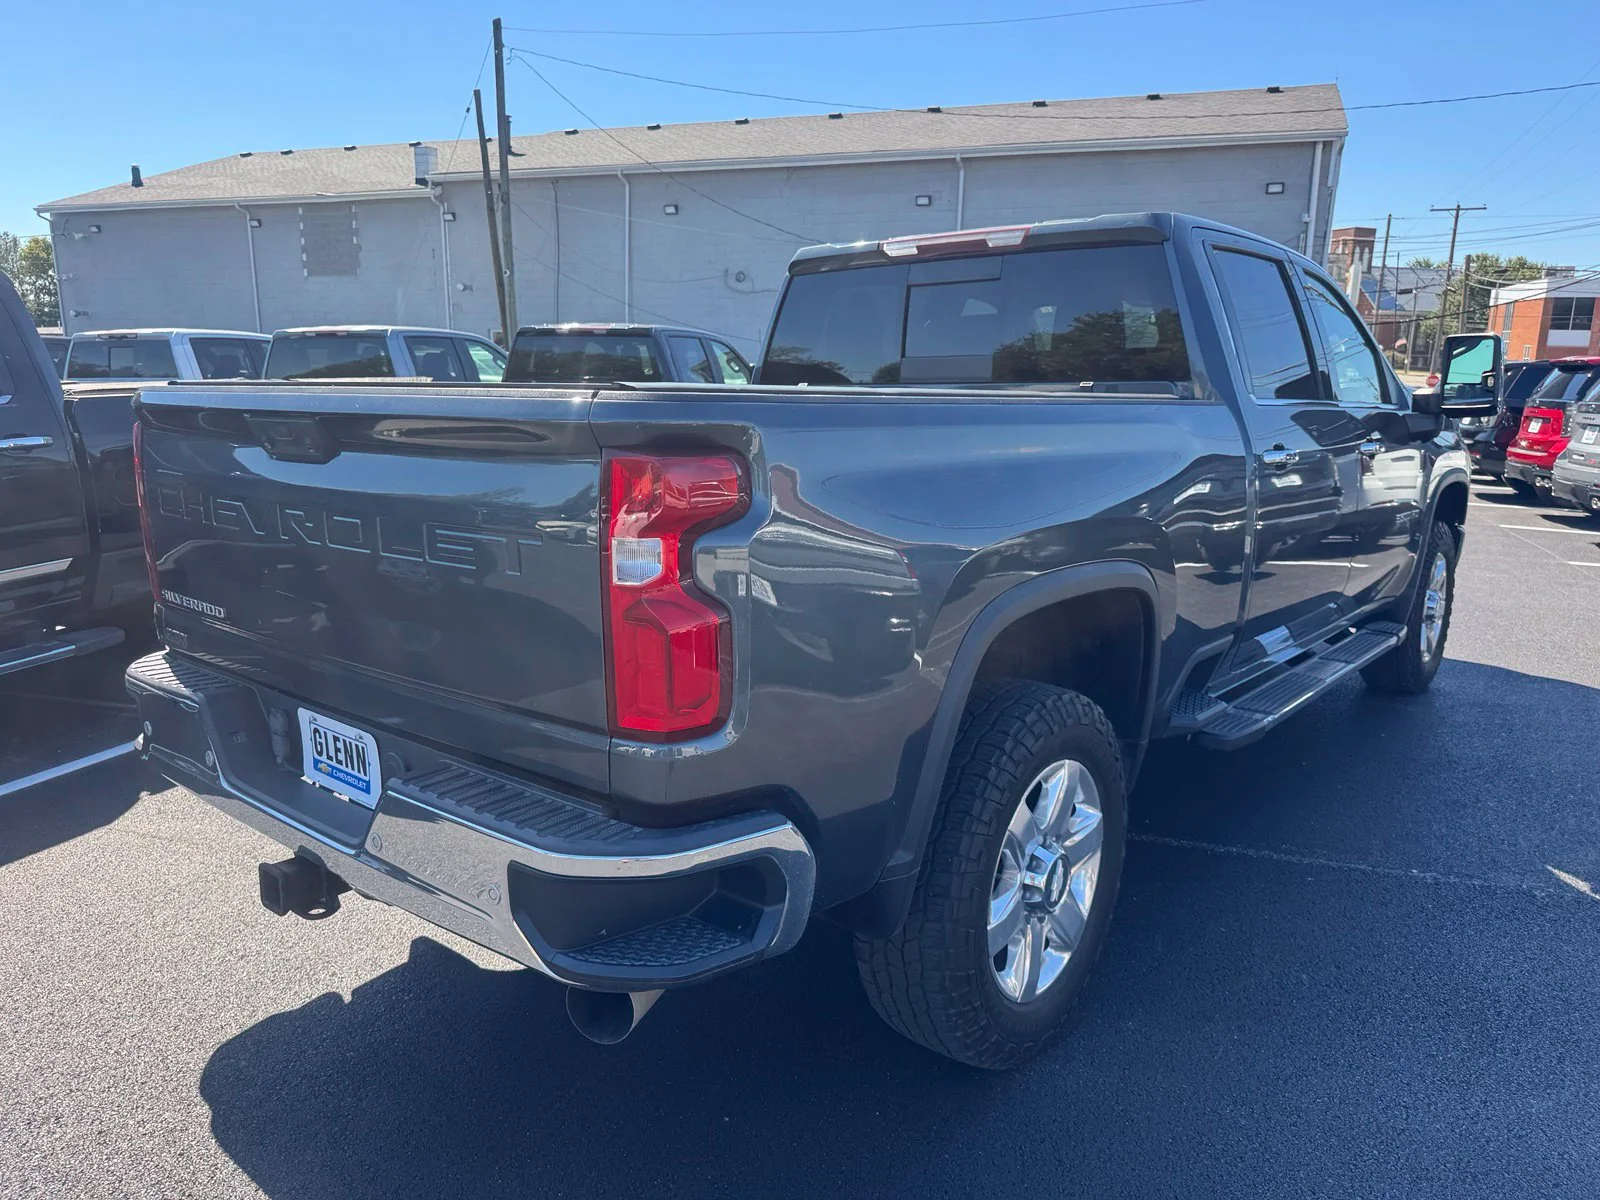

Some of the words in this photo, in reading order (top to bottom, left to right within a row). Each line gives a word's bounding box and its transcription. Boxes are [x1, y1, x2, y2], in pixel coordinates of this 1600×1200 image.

[158, 486, 543, 575] CHEVROLET
[161, 588, 225, 618] SILVERADO
[313, 727, 368, 777] GLENN
[333, 769, 367, 790] CHEVROLET
